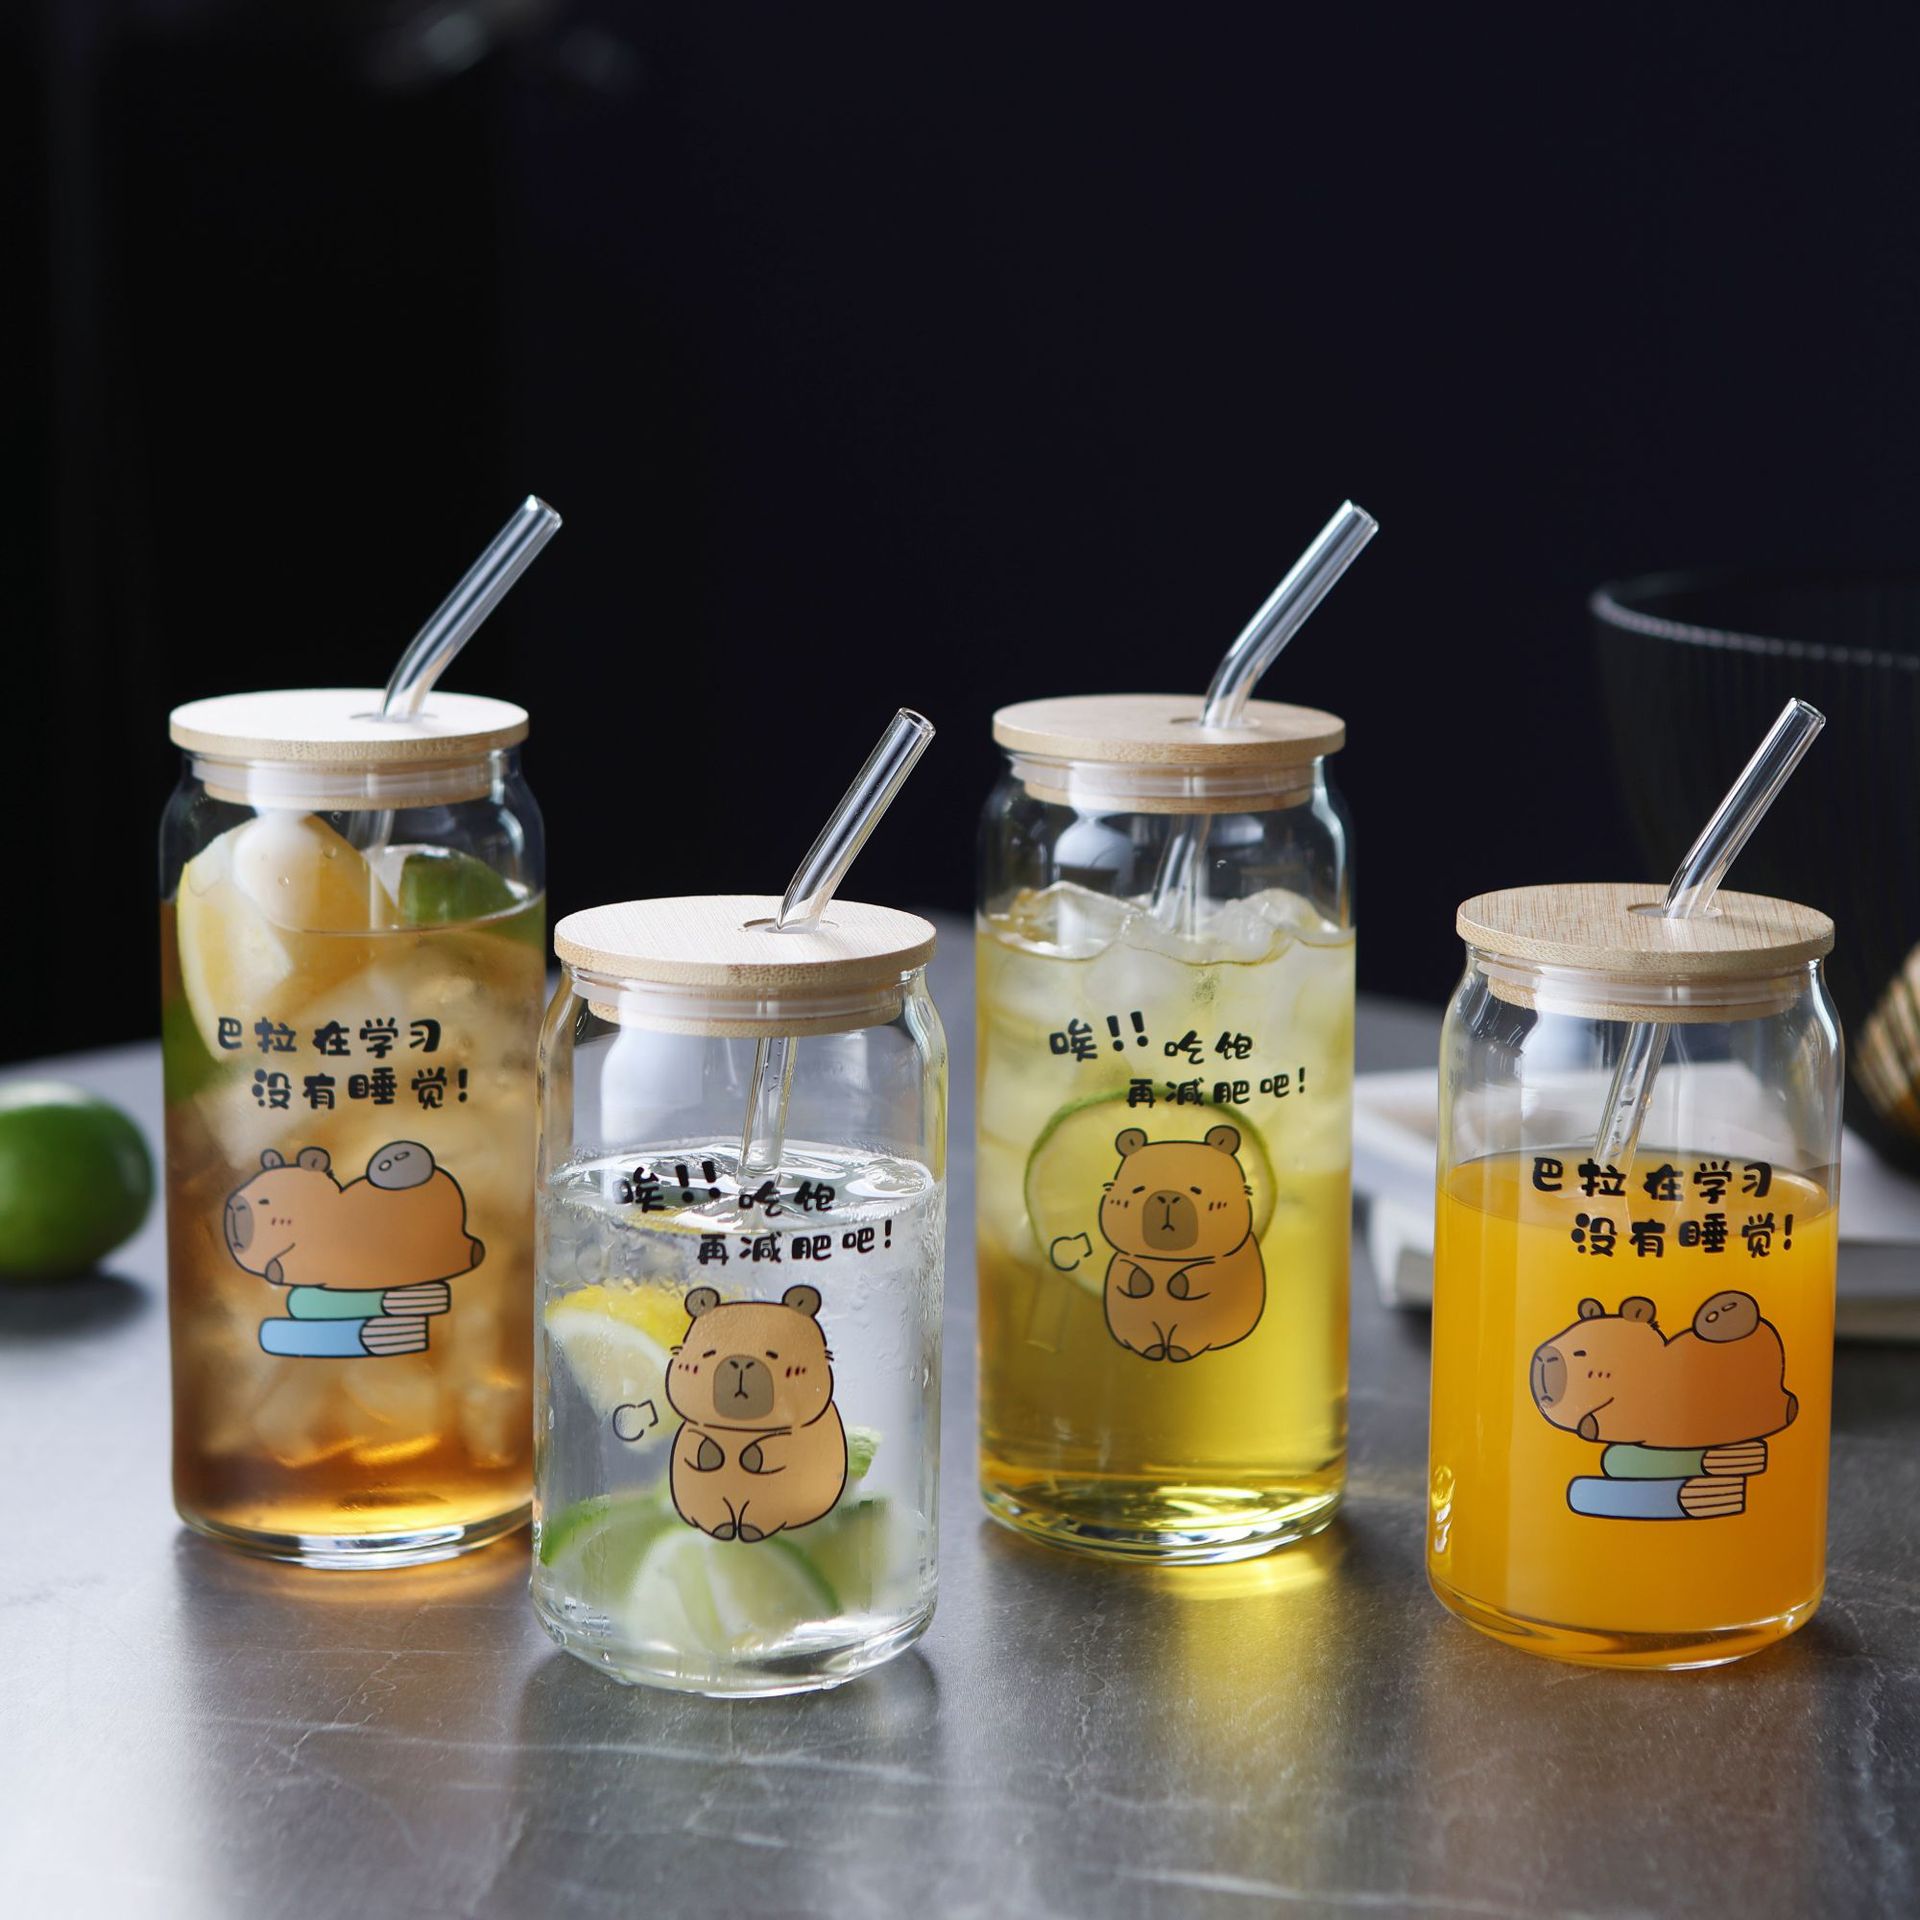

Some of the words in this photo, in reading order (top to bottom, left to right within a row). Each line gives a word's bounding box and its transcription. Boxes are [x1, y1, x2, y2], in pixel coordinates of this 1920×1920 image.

[218, 1016, 442, 1059] 巴拉在学习
[251, 1066, 469, 1110] 没有睡觉!
[1127, 1066, 1306, 1109] 再减肥吧!
[1532, 1157, 1773, 1204] 巴拉在学习
[698, 1219, 893, 1266] 再减肥吧!
[1571, 1212, 1794, 1259] 没有睡觉!
